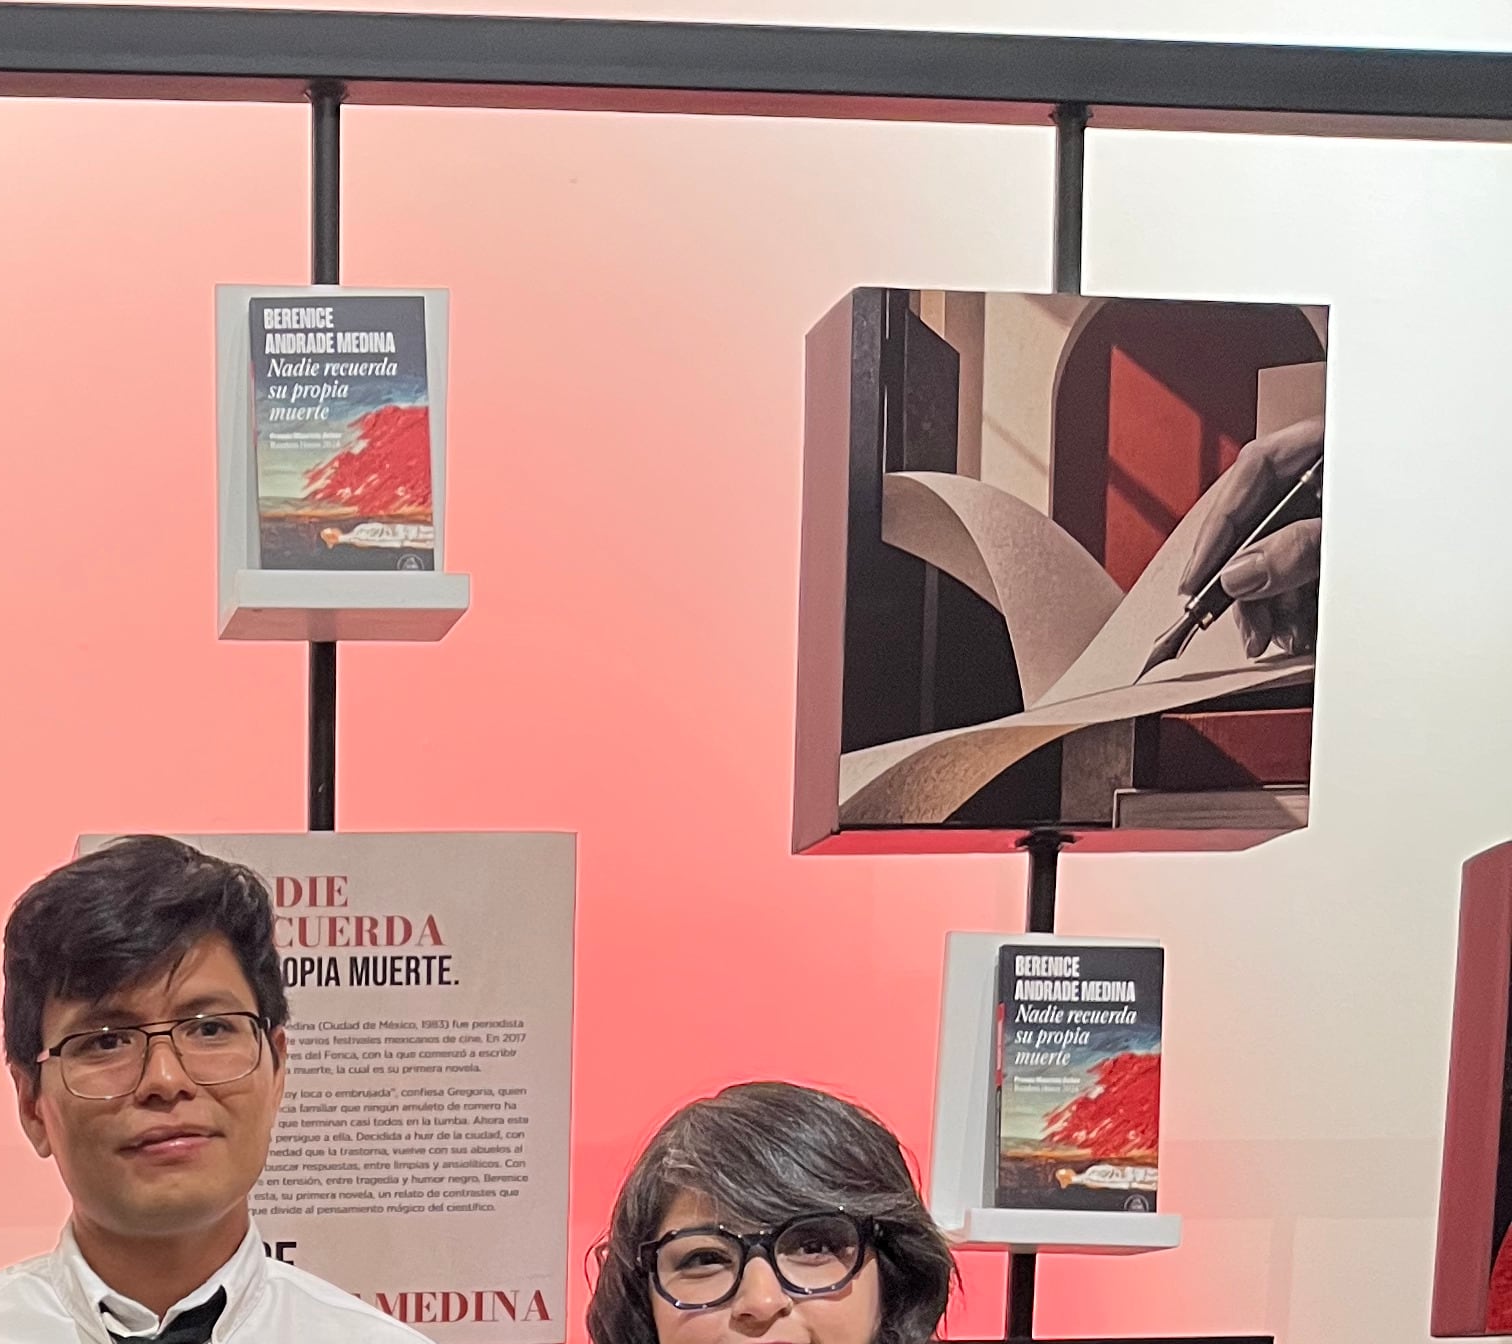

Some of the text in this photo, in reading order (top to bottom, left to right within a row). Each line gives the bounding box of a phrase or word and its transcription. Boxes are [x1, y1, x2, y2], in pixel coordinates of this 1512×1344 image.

[264, 307, 334, 329] BERENICE
[265, 331, 396, 354] ANDRADE MEDINA
[267, 358, 397, 378] Nadie recuerda
[269, 381, 348, 402] su propia
[270, 404, 329, 420] muerte
[274, 876, 348, 908] DIE
[274, 914, 447, 948] CUERDA
[283, 955, 459, 987] OPIA MUERTE.
[1015, 956, 1079, 977] BERENICE
[1014, 980, 1135, 1002] ANDRADE MEDINA
[1015, 1004, 1136, 1024] Nadie recuerda
[285, 1022, 315, 1030] edina
[363, 1021, 376, 1029] de
[453, 1020, 469, 1028] fue
[472, 1020, 524, 1030] periodista
[299, 1037, 329, 1045] varios
[333, 1036, 381, 1044] festivales
[385, 1036, 439, 1044] mexicanos
[443, 1035, 456, 1043] de
[487, 1033, 499, 1043] En
[503, 1033, 526, 1042] 2017
[1015, 1027, 1089, 1047] su propia
[305, 1051, 321, 1059] del
[385, 1050, 392, 1058] la
[396, 1051, 416, 1060] que
[479, 1049, 516, 1057] escribir
[1015, 1048, 1070, 1066] muerte
[337, 1065, 345, 1073] la
[349, 1065, 369, 1073] cual
[401, 1066, 442, 1074] primera
[301, 1090, 322, 1098] loca
[401, 1088, 444, 1097] confiesa
[498, 1088, 527, 1096] quien
[271, 1206, 301, 1215] divide
[305, 1206, 314, 1214] al
[317, 1205, 383, 1215] pensamiento
[387, 1203, 424, 1214] mágico
[428, 1203, 443, 1212] del
[375, 1289, 552, 1323] MEDINA
